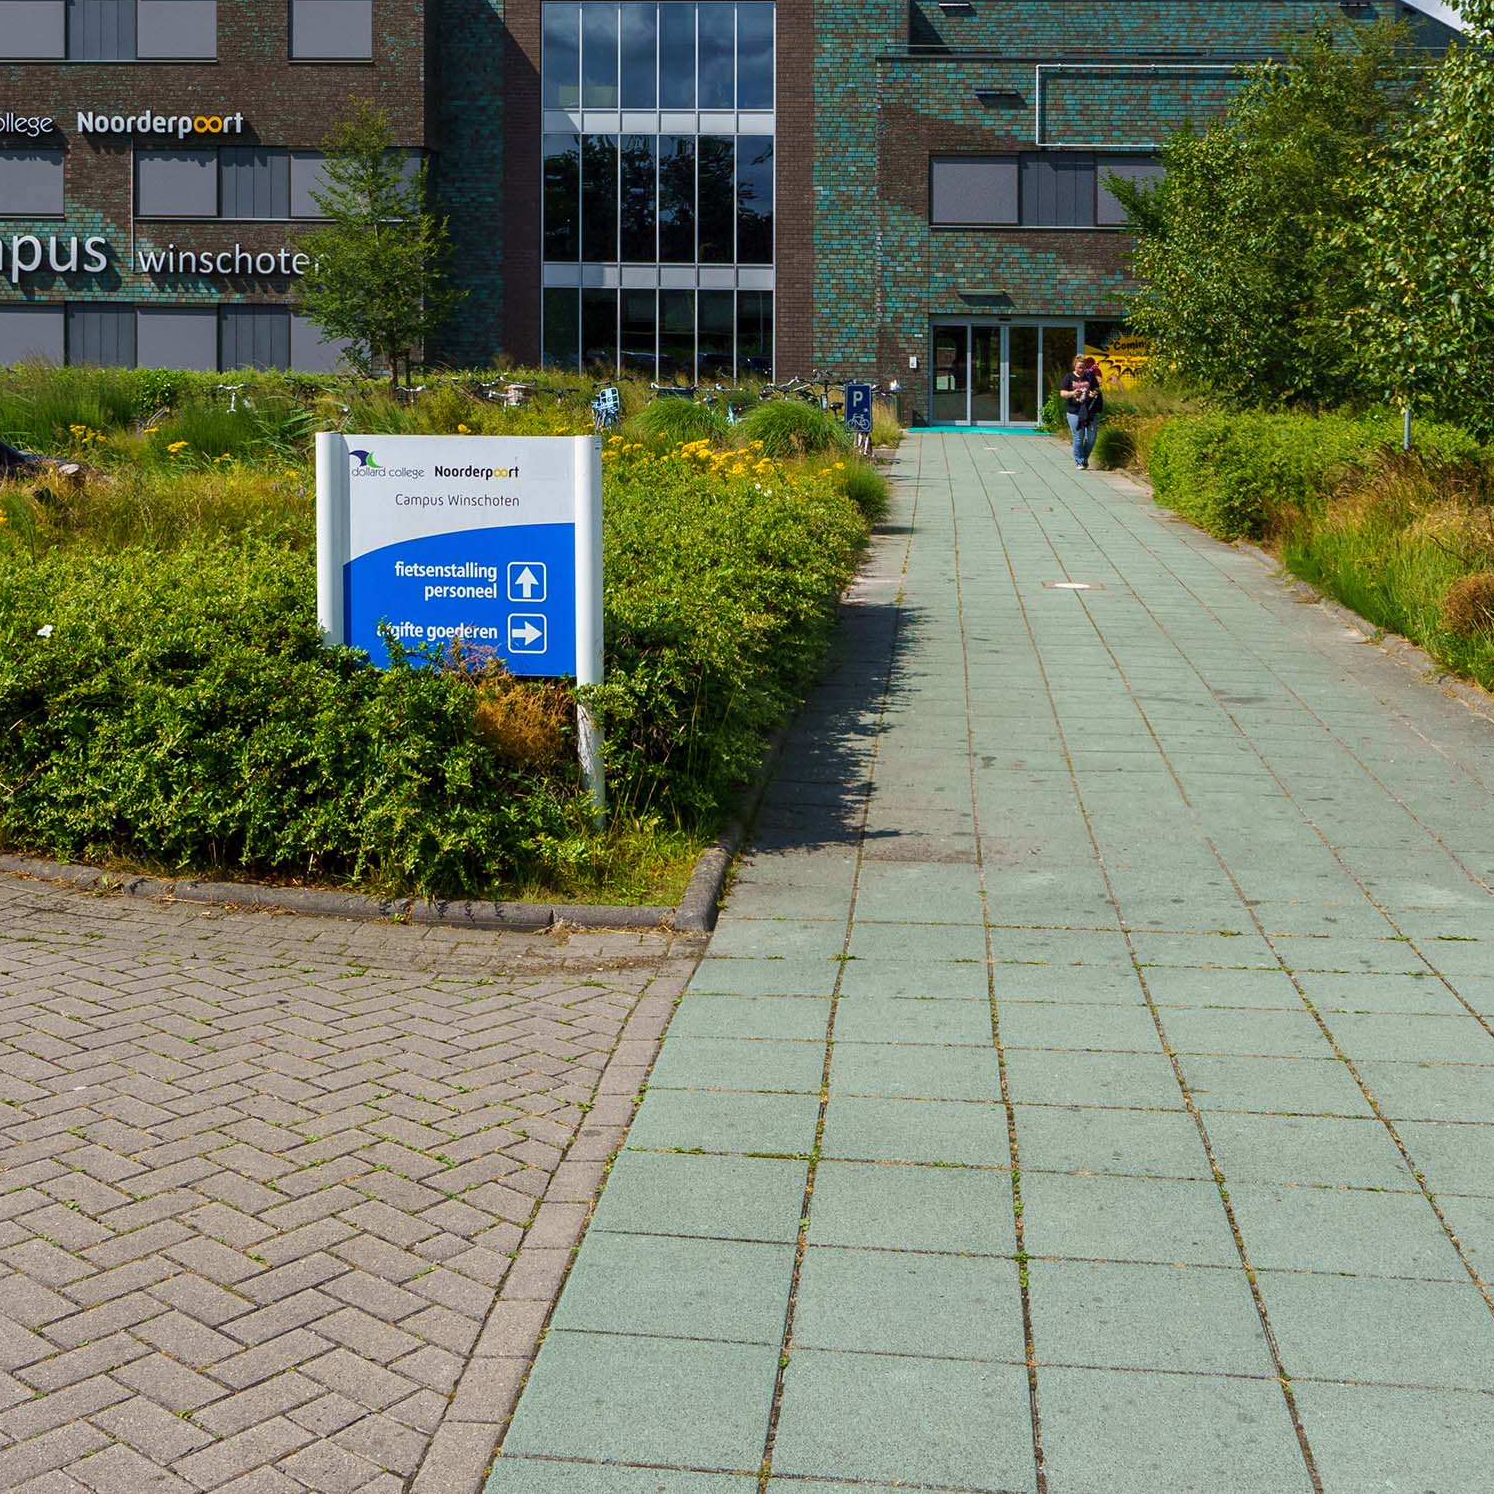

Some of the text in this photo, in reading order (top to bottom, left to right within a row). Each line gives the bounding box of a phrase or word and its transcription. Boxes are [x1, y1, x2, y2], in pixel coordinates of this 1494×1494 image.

[77, 110, 244, 139] Noorderpoort
[852, 390, 864, 408] P
[351, 466, 425, 480] dollard college
[434, 465, 520, 481] Noorderpoort
[395, 493, 520, 508] Campus Winschoten
[394, 561, 498, 582] fietsenstalling
[424, 583, 498, 601] personeel
[427, 622, 498, 642] goederen
